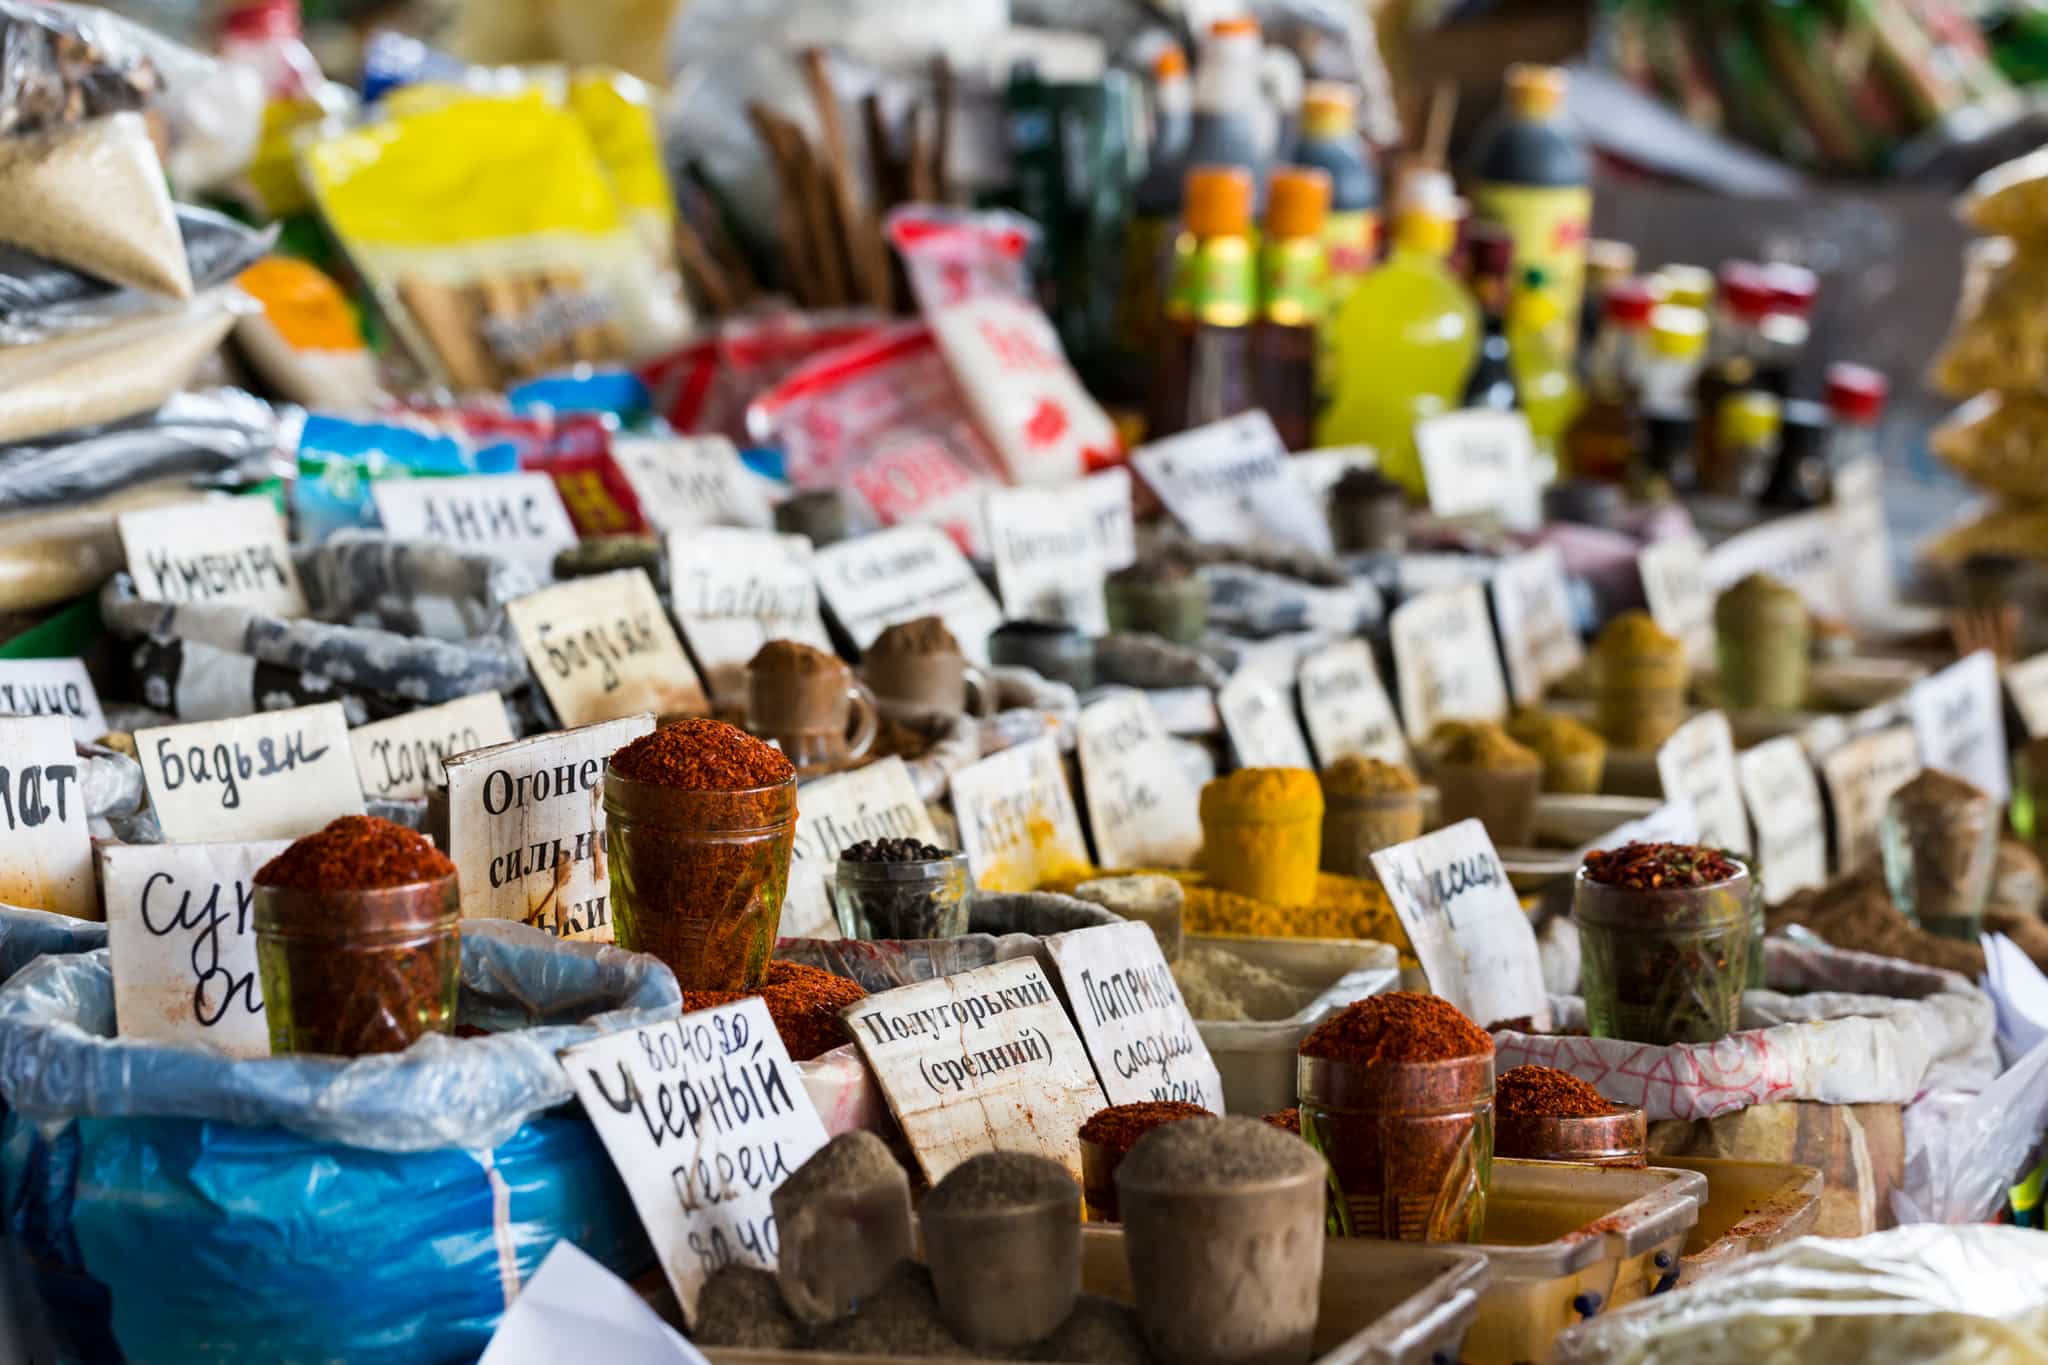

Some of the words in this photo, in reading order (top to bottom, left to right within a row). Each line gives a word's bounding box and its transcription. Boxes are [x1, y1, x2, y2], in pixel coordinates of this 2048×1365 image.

[157, 731, 329, 808] Бадьян
[483, 756, 611, 815] Огоне
[862, 972, 1050, 1043] Полугорький
[587, 1039, 795, 1148] Черный
[919, 1026, 1053, 1095] (средний)
